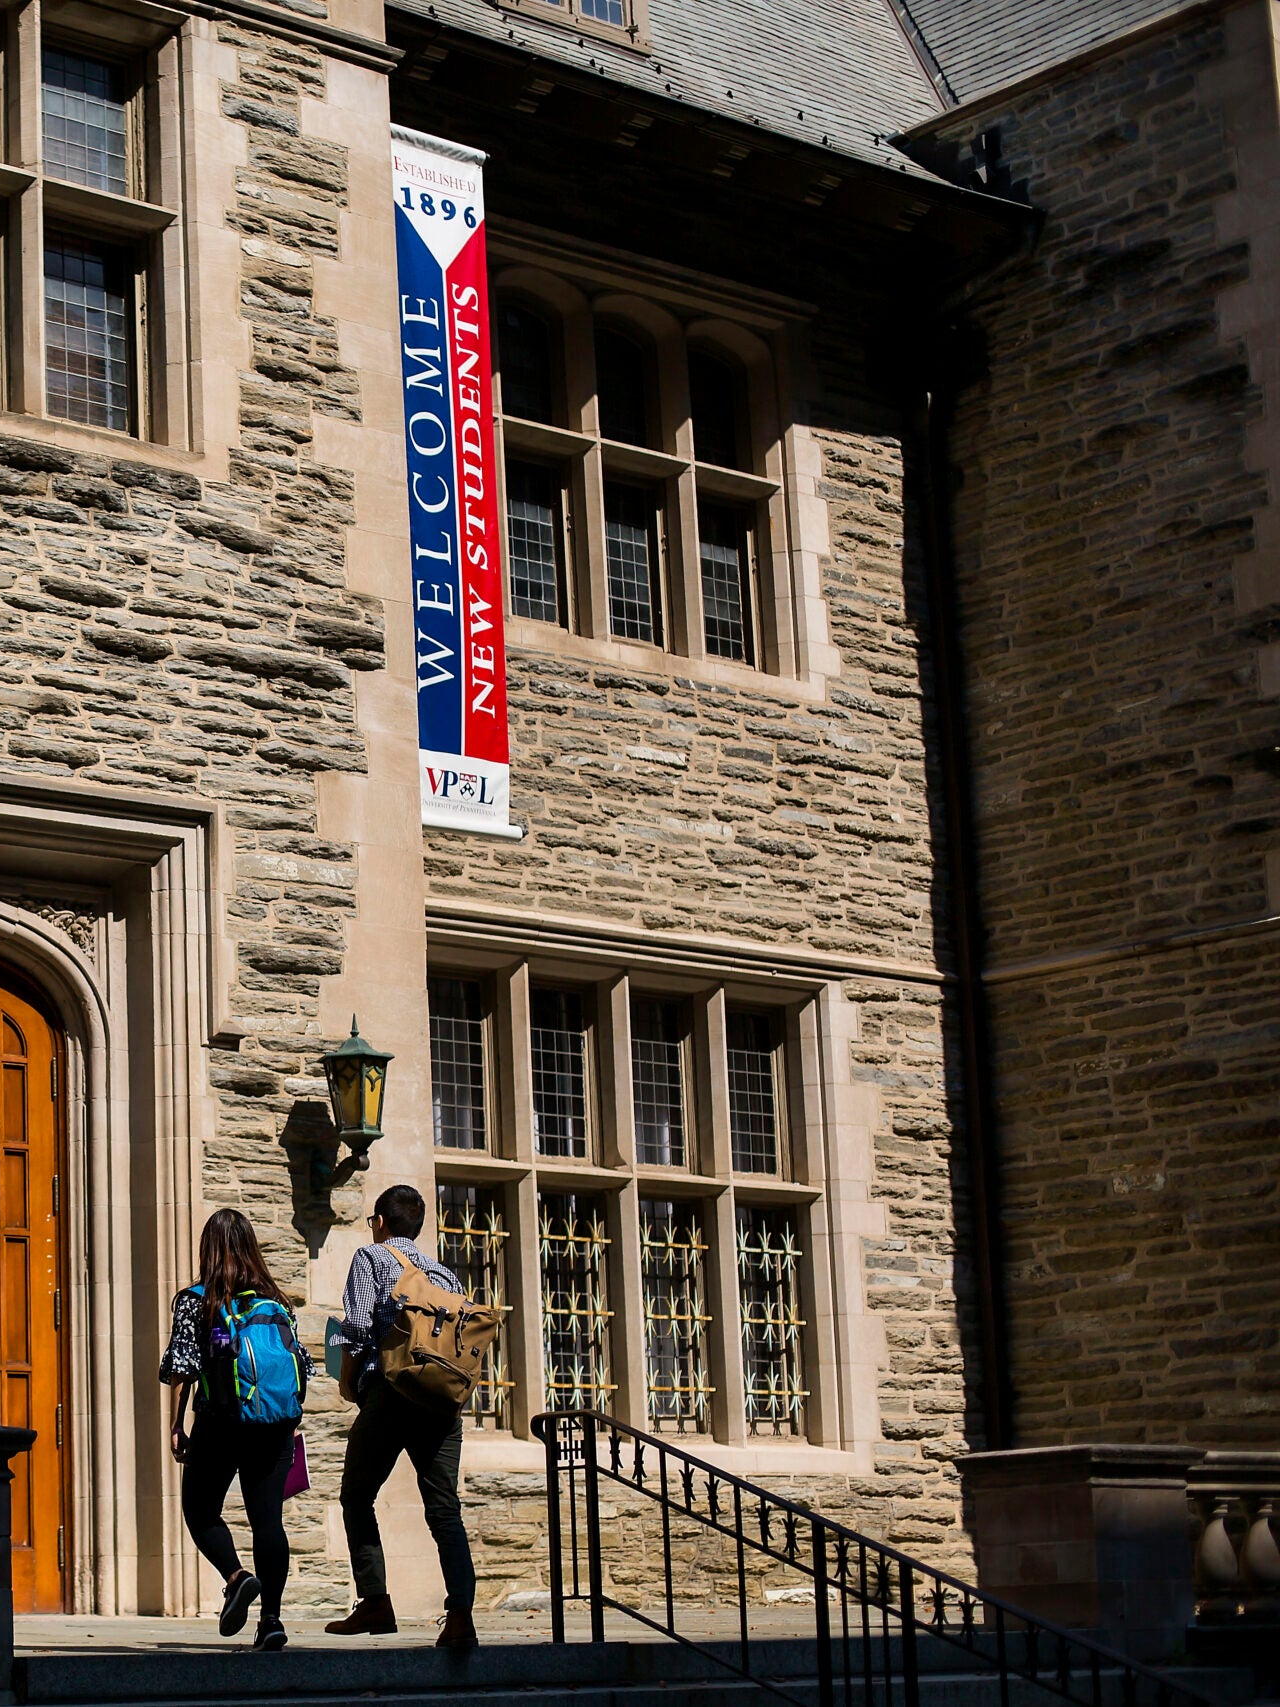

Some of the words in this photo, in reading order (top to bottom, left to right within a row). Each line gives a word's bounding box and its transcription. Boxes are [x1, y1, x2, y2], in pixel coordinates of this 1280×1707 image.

[393, 155, 476, 193] ESTABLISHED
[400, 187, 477, 229] 1896
[401, 294, 455, 693] WELCOME
[451, 282, 489, 570] STUDENTS
[468, 583, 496, 719] NEW
